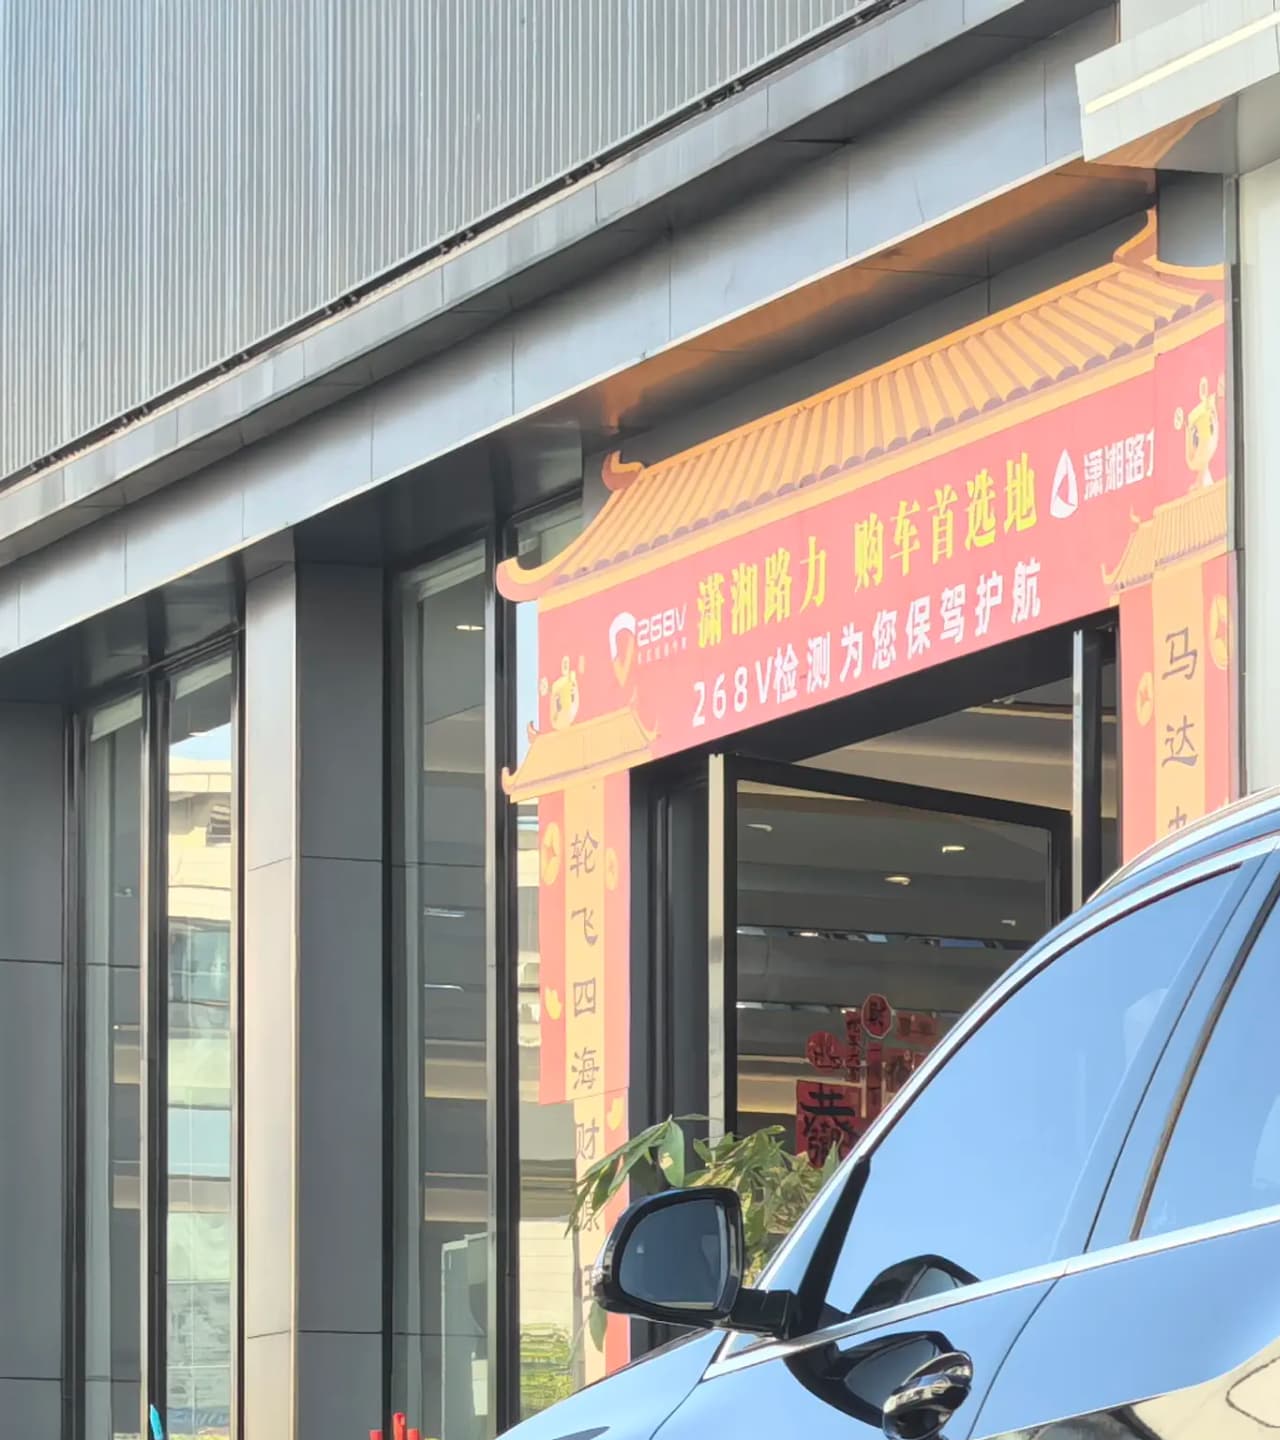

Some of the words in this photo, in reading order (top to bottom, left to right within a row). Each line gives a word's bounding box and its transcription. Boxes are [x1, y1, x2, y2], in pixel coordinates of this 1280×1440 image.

[697, 535, 827, 648] 潇湘路力
[854, 451, 1038, 592] 购车首选地
[637, 602, 688, 646] 268V
